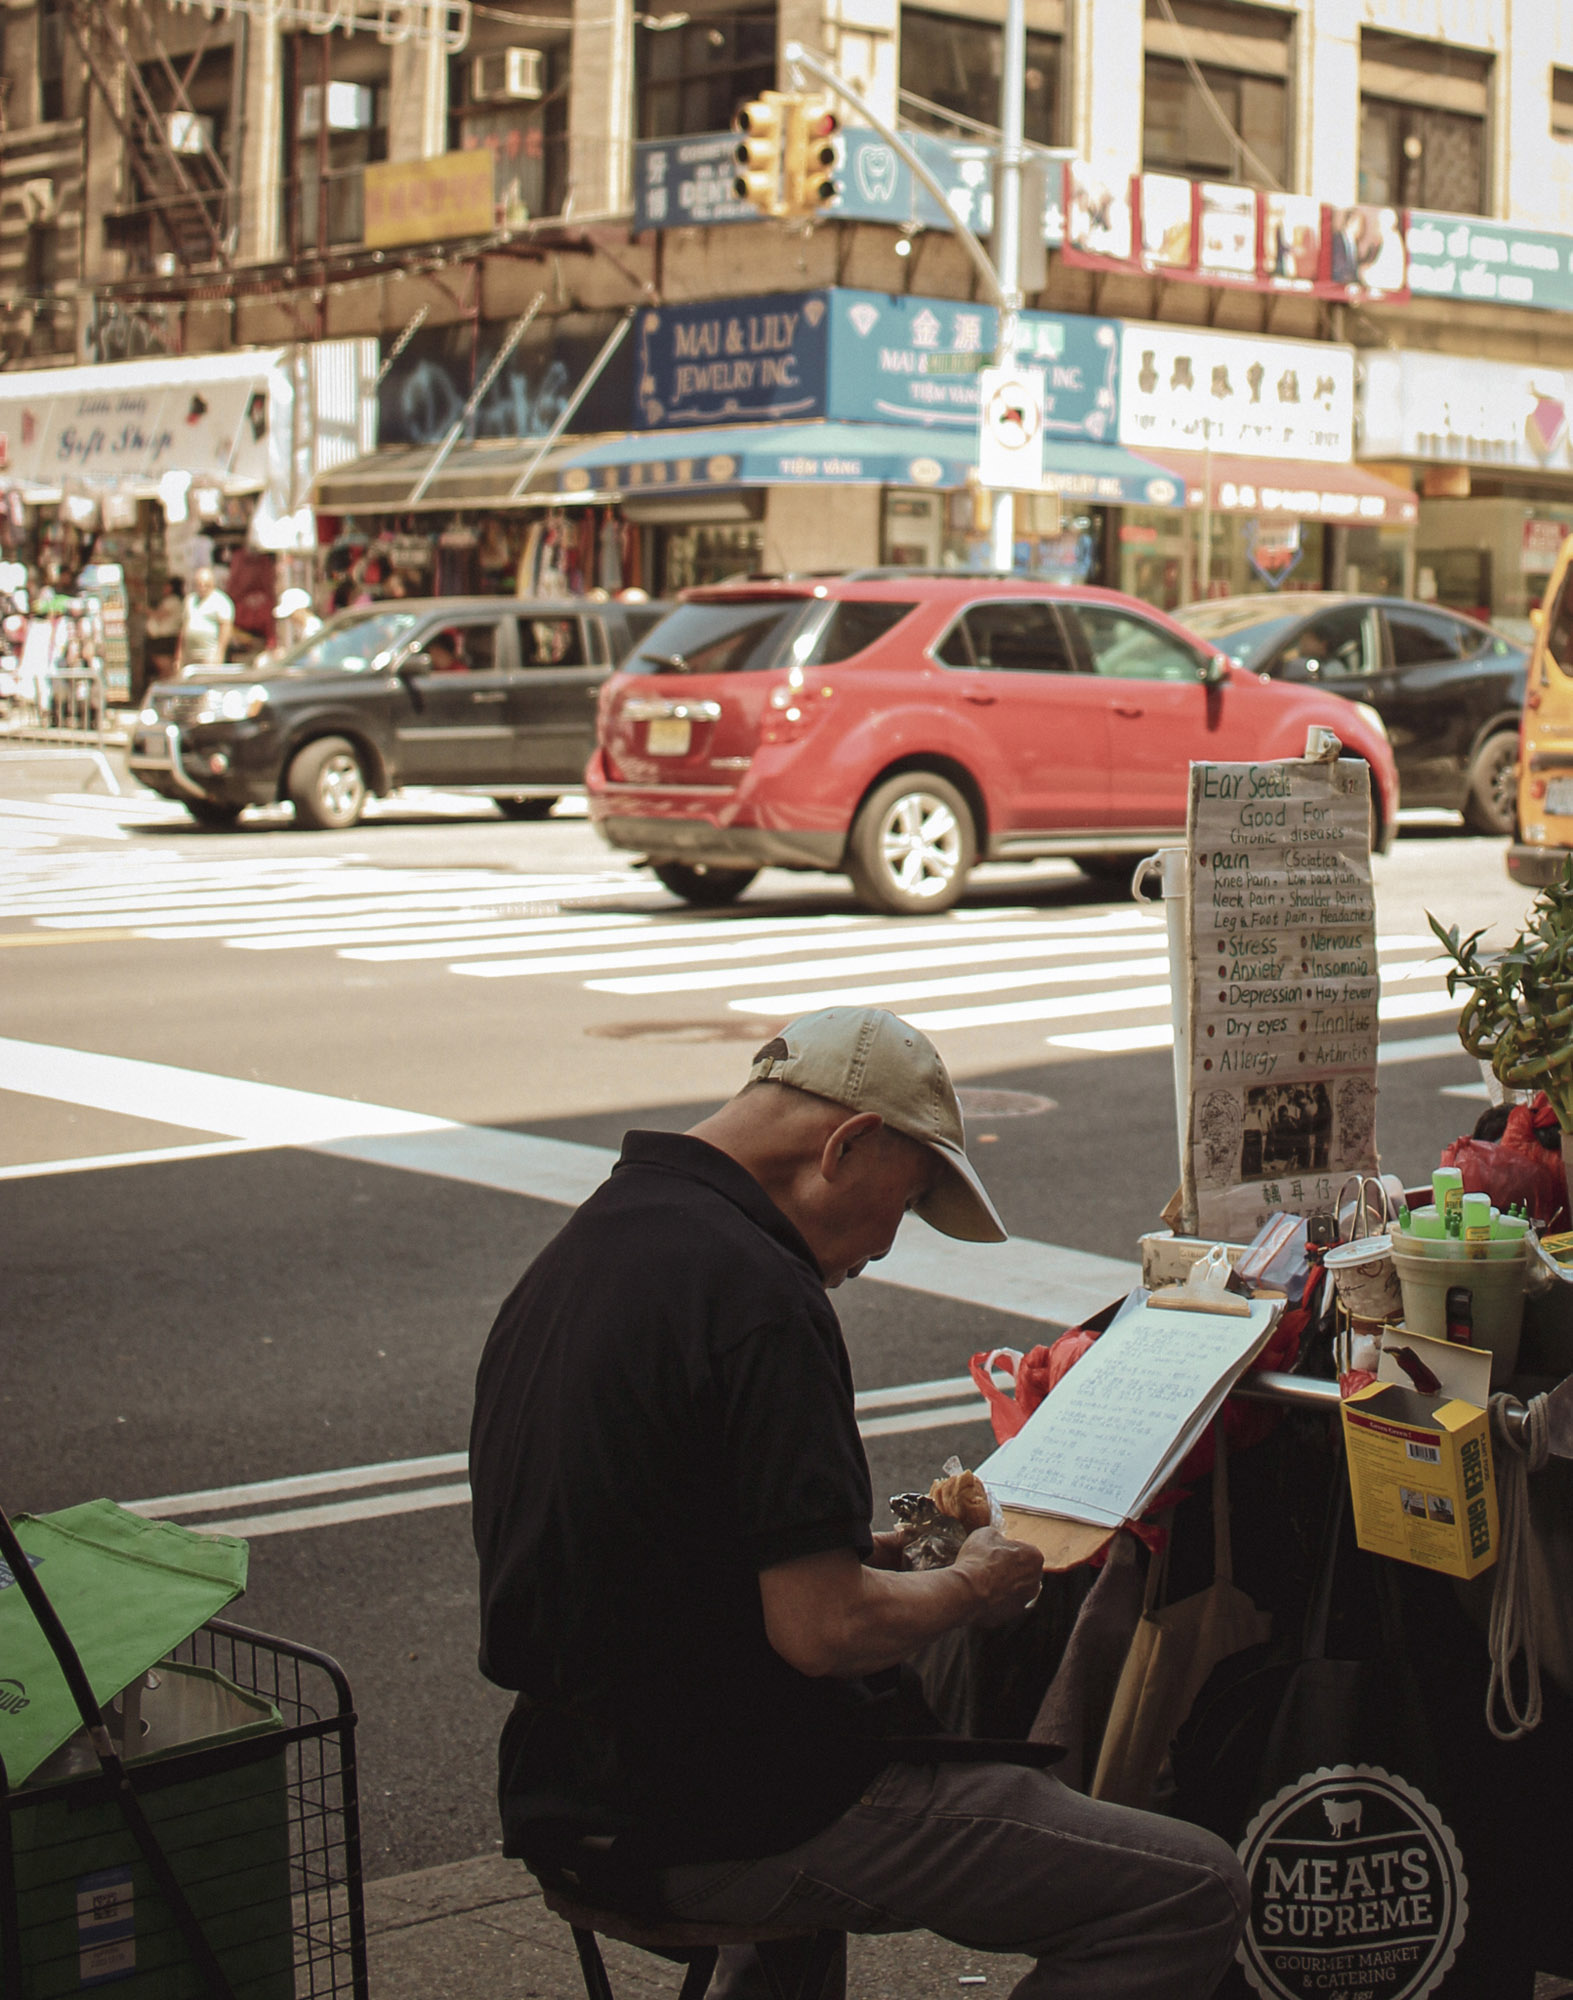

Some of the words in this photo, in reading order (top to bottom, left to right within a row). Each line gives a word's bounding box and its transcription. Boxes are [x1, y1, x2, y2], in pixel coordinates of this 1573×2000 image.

[674, 320, 721, 358] MAI
[725, 317, 744, 354] &
[749, 312, 799, 352] LILY
[880, 348, 915, 372] MAI
[671, 360, 757, 404] JEWELRY
[761, 353, 799, 388] INC.
[58, 427, 106, 465] Gift
[1204, 766, 1244, 799] Ear
[1240, 803, 1286, 828] Good
[1303, 801, 1330, 824] For
[1290, 826, 1344, 842] diseases
[1213, 891, 1244, 908] Neck
[1214, 911, 1237, 932] Leg
[1251, 911, 1279, 928] Foot
[1229, 935, 1278, 957] Stress
[1310, 931, 1362, 951] Nervous
[1230, 957, 1286, 981] Anxiety
[1311, 956, 1369, 979] Insomnia
[1229, 983, 1303, 1008] Depression
[1315, 984, 1339, 1004] Hay
[1343, 984, 1375, 1004] fever
[1226, 1017, 1252, 1037] Dry
[1257, 1017, 1289, 1036] eyes
[1219, 1050, 1278, 1076] Allergy
[1461, 1438, 1484, 1500] GREEN
[1467, 1498, 1491, 1560] GREEN
[1263, 1847, 1430, 1902] MEATS
[1262, 1894, 1433, 1938] SUPREME
[1275, 1954, 1356, 1972] GOURMET
[1359, 1945, 1421, 1966] MARKET
[1303, 1976, 1313, 1988] &
[1316, 1966, 1397, 1988] CATERING
